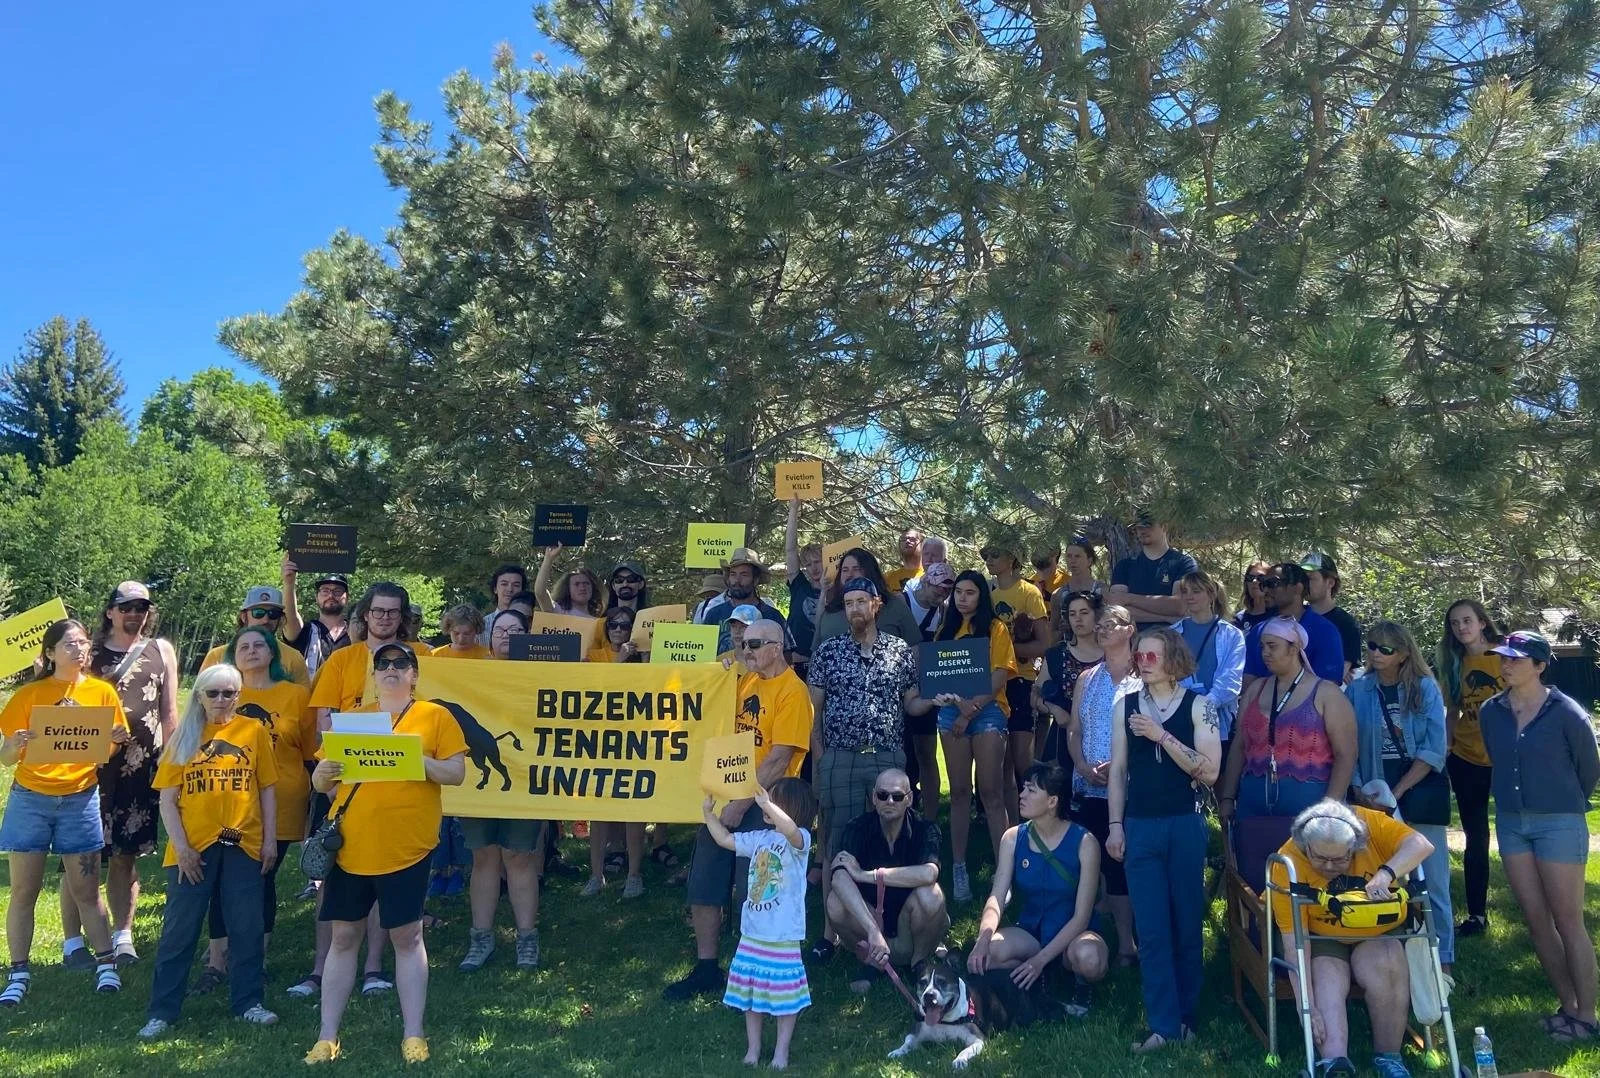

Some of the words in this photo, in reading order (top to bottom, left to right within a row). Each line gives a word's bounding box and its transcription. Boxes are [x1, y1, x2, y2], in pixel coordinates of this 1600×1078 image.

[785, 473, 815, 481] Eviction
[697, 538, 732, 546] Eviction
[19, 636, 43, 652] KILL
[528, 643, 560, 651] Tenants
[663, 639, 704, 650] Eviction
[670, 652, 697, 662] KILLS
[937, 649, 970, 658] Tenants
[938, 658, 972, 667] DESERVE
[926, 666, 984, 678] representation
[536, 688, 703, 721] BOZEMAN
[43, 725, 100, 736] Eviction
[53, 740, 89, 751] KILLS
[533, 727, 689, 762] TENANTS
[343, 748, 405, 757] Eviction
[358, 759, 397, 767] KILLS
[716, 754, 749, 769] Eviction
[206, 768, 253, 779] TENANTS
[723, 771, 747, 783] KILLS
[186, 778, 251, 794] UNITED
[528, 765, 657, 799] UNITED
